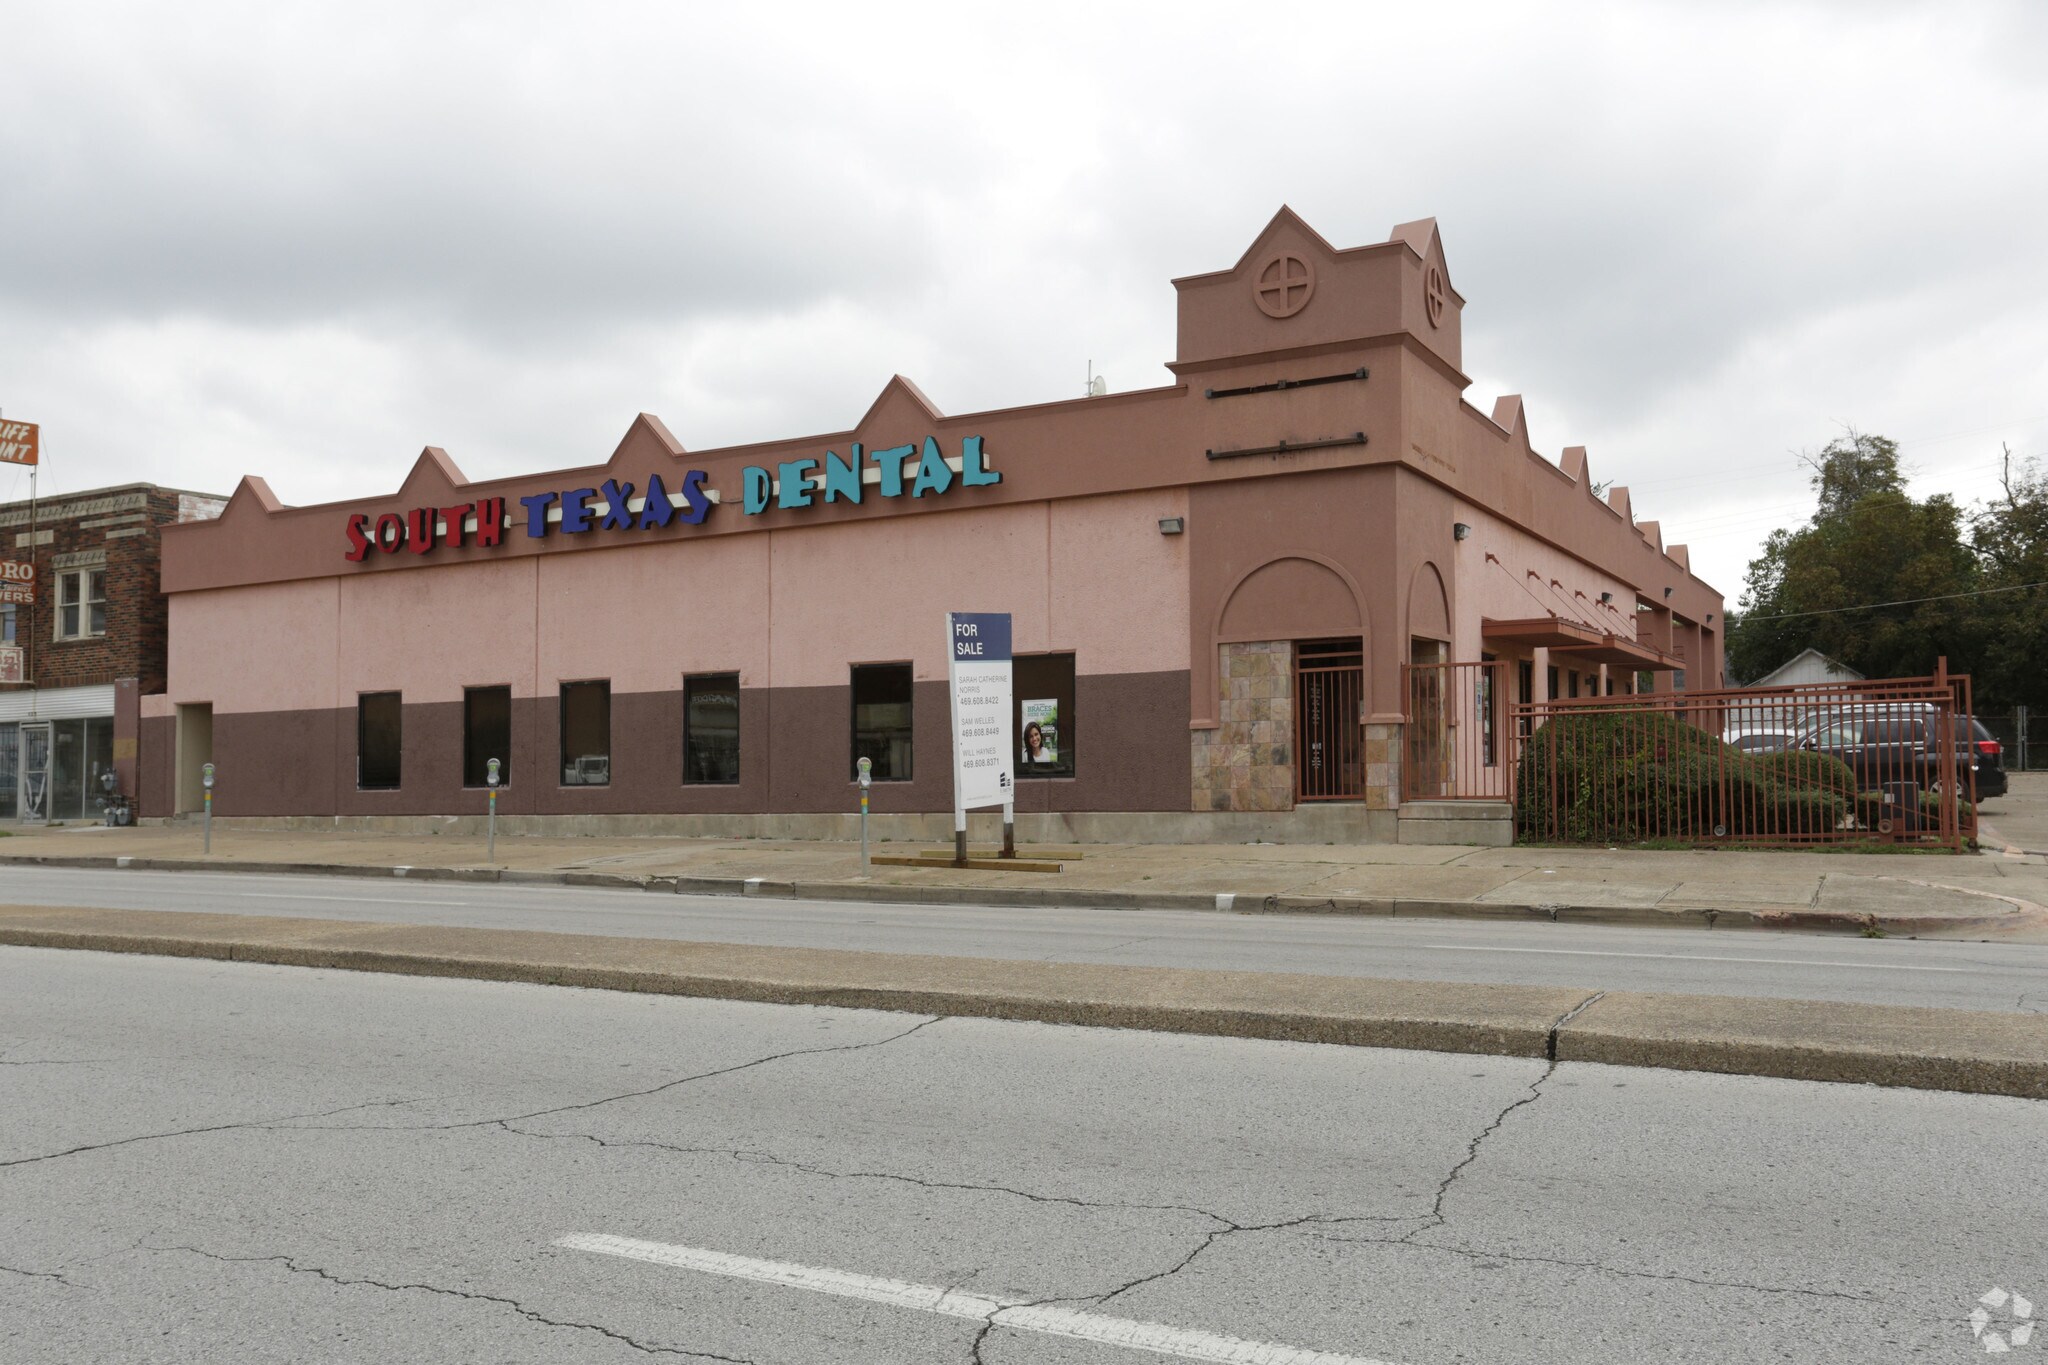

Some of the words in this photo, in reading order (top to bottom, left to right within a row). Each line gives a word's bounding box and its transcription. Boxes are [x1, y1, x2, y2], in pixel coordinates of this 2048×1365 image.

[345, 497, 505, 562] SOUTH
[520, 470, 712, 538] TEXAS
[742, 435, 1003, 515] DENTAL
[0, 562, 33, 580] RO
[956, 624, 978, 637] FOR
[957, 642, 983, 655] SALE
[959, 676, 977, 684] SARAH
[979, 675, 1008, 683] CATHERINE
[959, 686, 980, 694] NORRIS
[961, 696, 999, 706] 469.608.8422
[961, 718, 973, 726] SAM
[974, 716, 995, 725] WELLES
[962, 749, 975, 757] WILL
[976, 747, 996, 756] HAYNES
